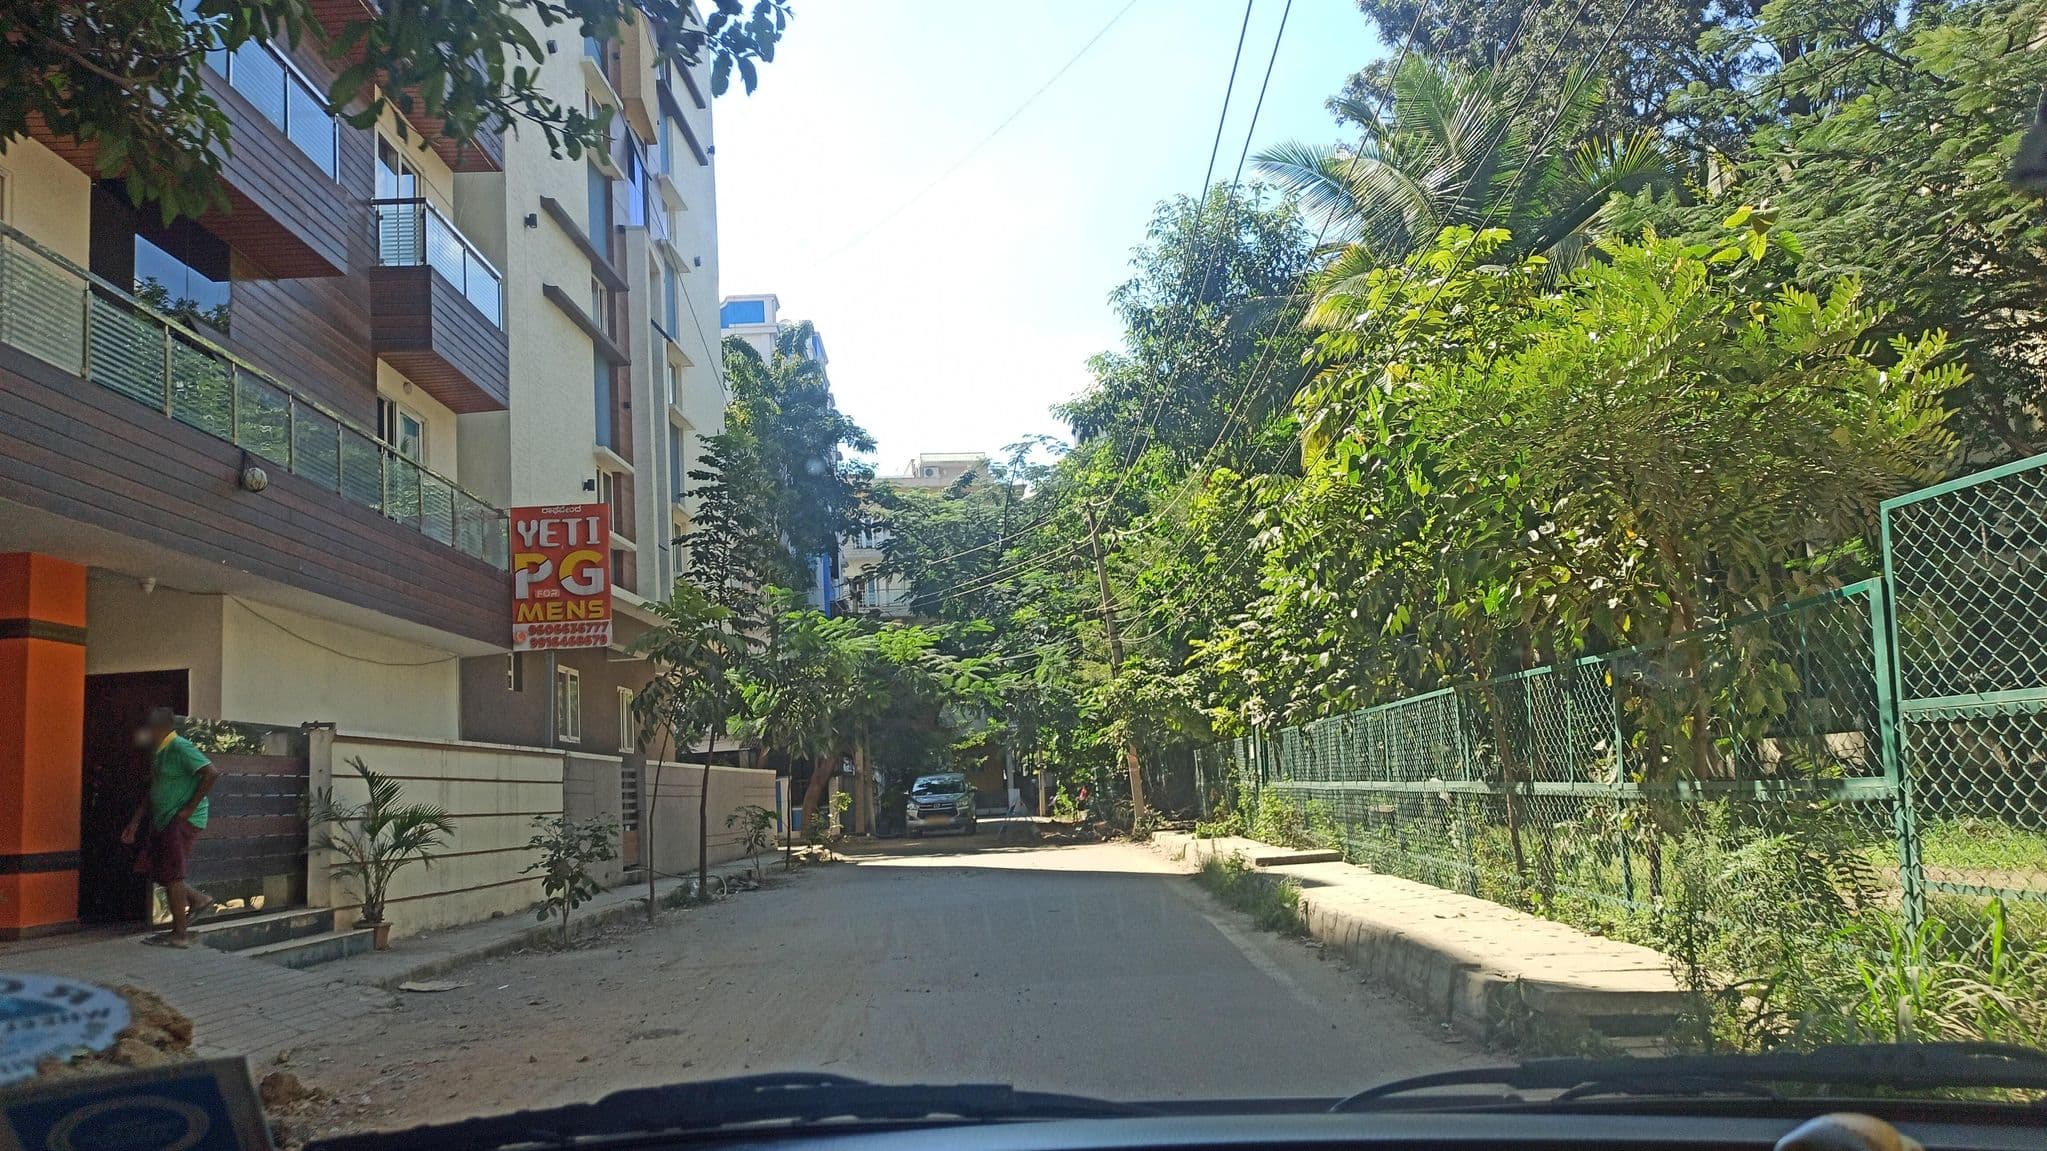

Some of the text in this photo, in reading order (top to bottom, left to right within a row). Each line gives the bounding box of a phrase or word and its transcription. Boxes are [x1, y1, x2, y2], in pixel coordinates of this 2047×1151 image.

[517, 516, 601, 548] YETI
[514, 549, 605, 600] PG
[535, 589, 560, 598] FOR
[517, 600, 604, 622] MENS
